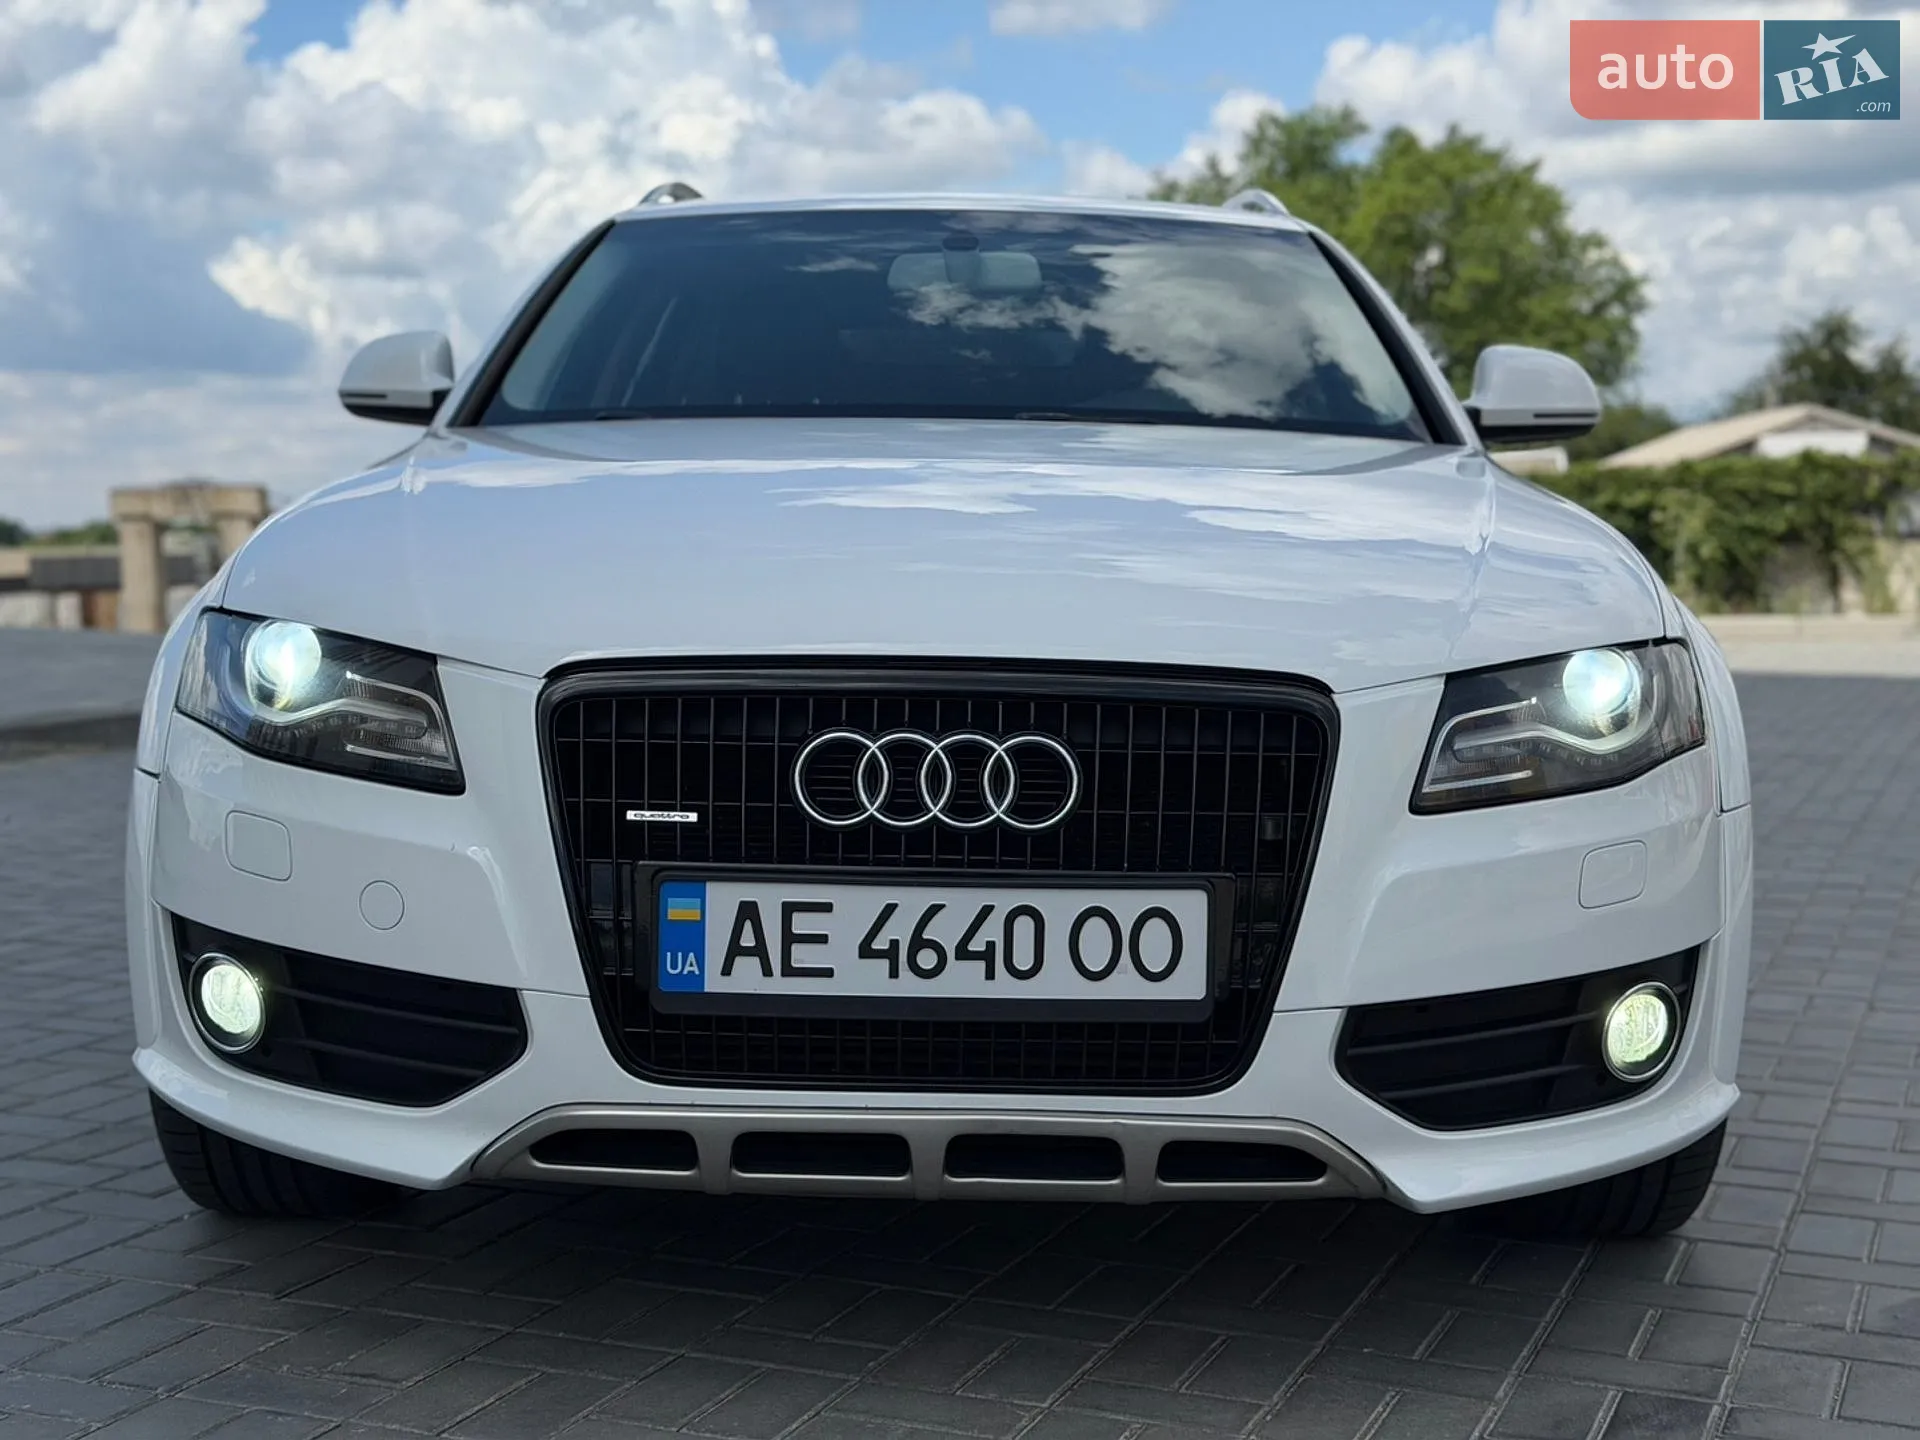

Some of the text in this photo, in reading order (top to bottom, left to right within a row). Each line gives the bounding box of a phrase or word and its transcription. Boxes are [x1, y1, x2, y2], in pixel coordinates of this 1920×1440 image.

[666, 951, 700, 975] UA
[720, 900, 1183, 983] AE 4640 OO
